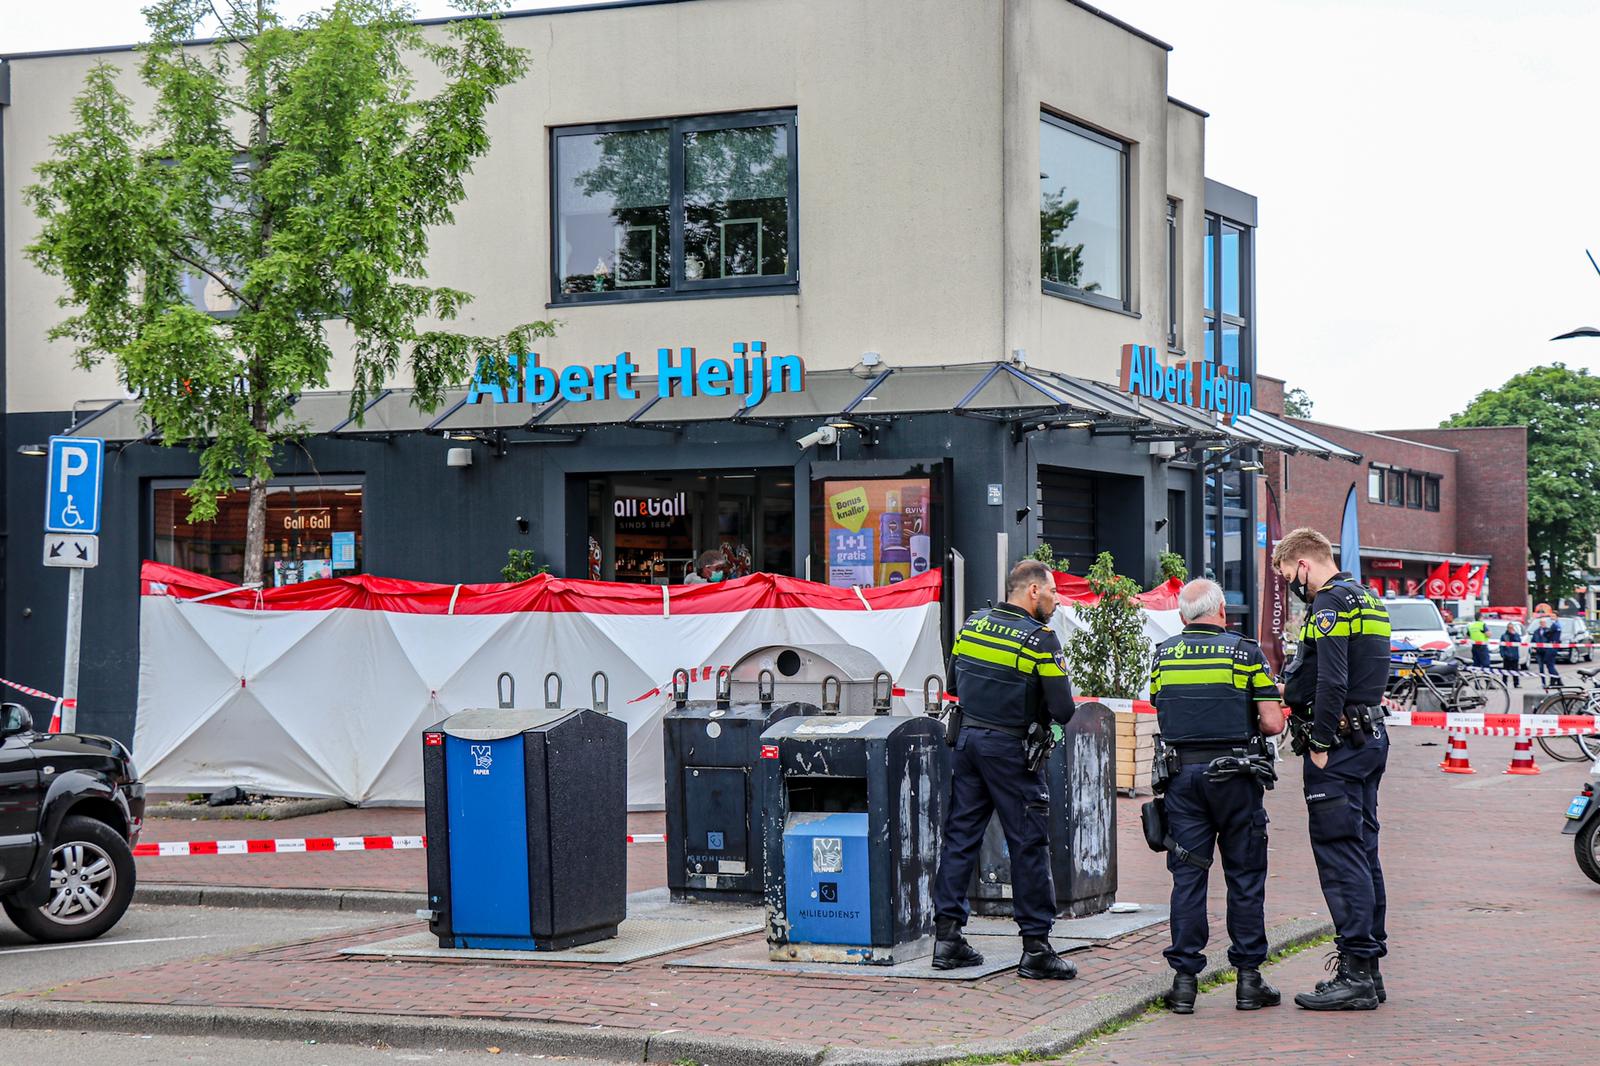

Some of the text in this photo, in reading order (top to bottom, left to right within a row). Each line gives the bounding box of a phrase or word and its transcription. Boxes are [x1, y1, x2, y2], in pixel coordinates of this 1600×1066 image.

[466, 341, 805, 408] Albert Heijn
[1125, 343, 1252, 427] Albert Heijn
[60, 446, 88, 492] P
[614, 499, 637, 517] all
[836, 495, 862, 510] Bonus
[836, 505, 865, 521] knaller
[283, 515, 305, 529] Gall
[310, 515, 331, 529] Gall
[619, 521, 647, 529] SINDS
[836, 534, 868, 550] 1+1
[836, 550, 866, 564] gratis
[969, 615, 1020, 638] POLITIE
[1166, 640, 1225, 659] POLITIE
[799, 909, 860, 919] MILIEUDIENST
